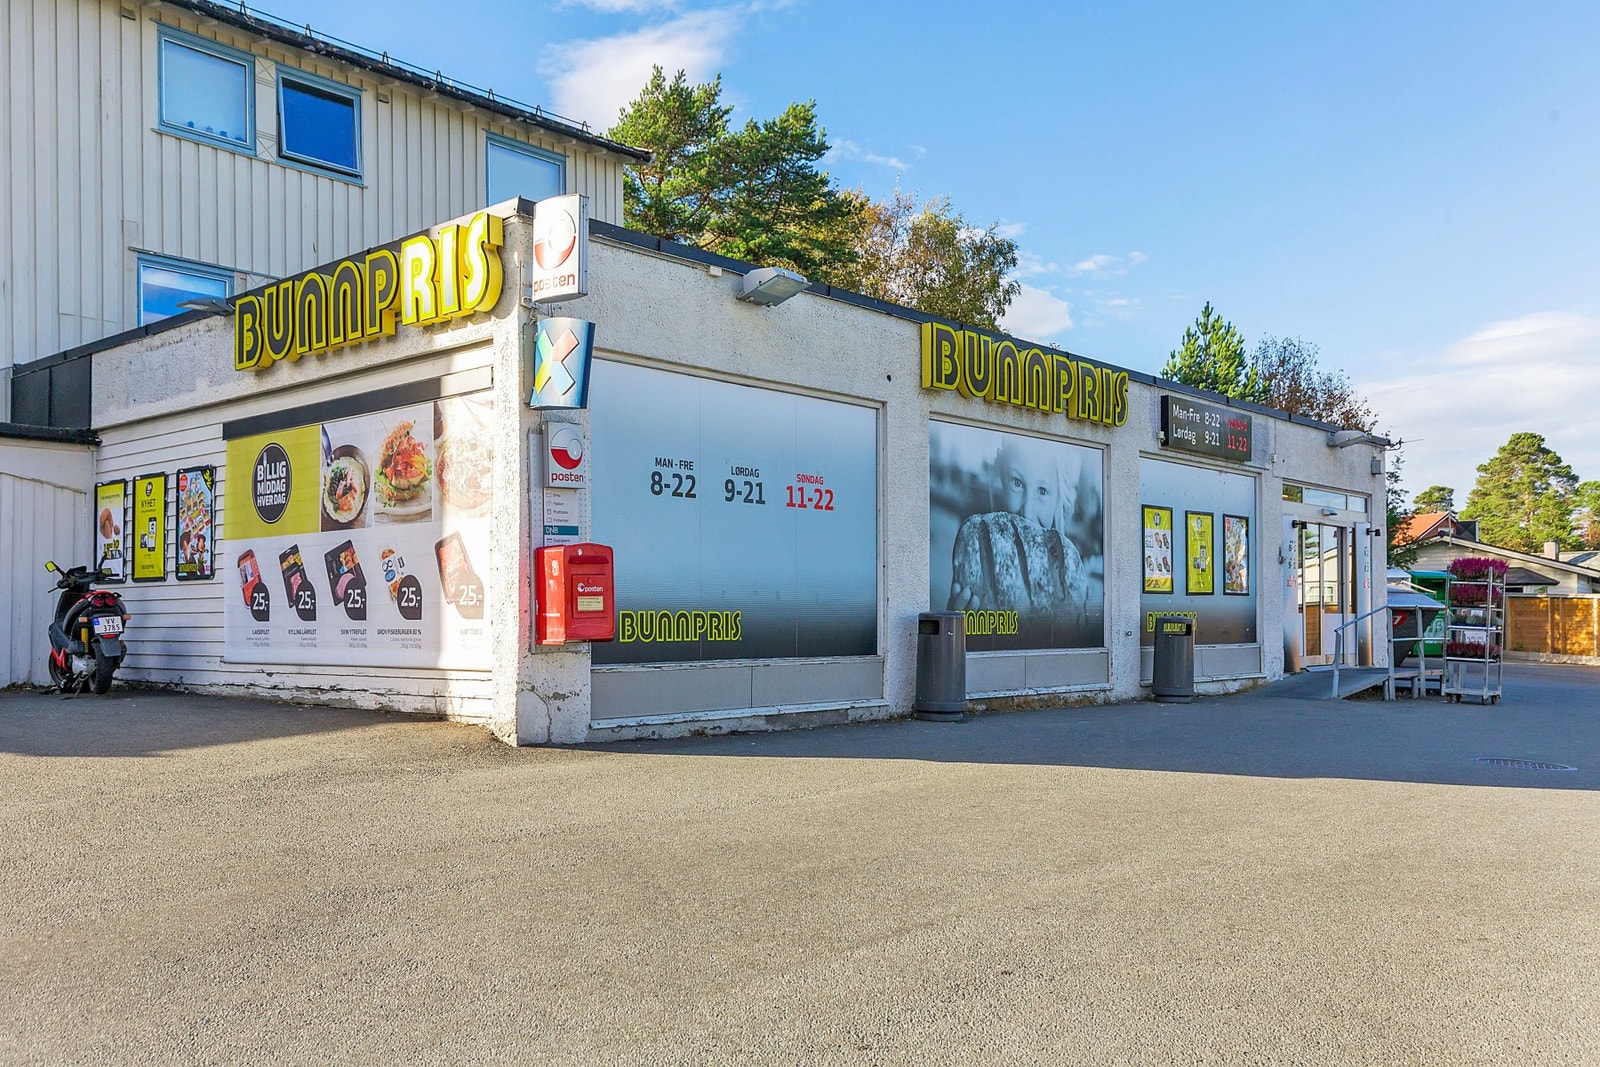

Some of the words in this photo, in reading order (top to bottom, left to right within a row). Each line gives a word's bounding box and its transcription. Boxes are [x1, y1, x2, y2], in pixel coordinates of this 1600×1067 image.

[235, 212, 503, 371] BUNNPRIS
[533, 273, 575, 296] posten
[921, 322, 1129, 427] BUNNPRIS
[655, 457, 674, 469] MAN
[679, 460, 694, 470] FRE
[730, 466, 760, 478] LØRDAG
[551, 472, 584, 483] posten
[650, 471, 697, 499] 8-22
[796, 473, 824, 485] SØNDAG
[724, 479, 766, 505] 9-21
[786, 485, 835, 511] 11-22
[545, 525, 559, 536] DNB
[619, 610, 742, 643] BUNNPRIS
[955, 610, 1018, 635] NNPRIS
